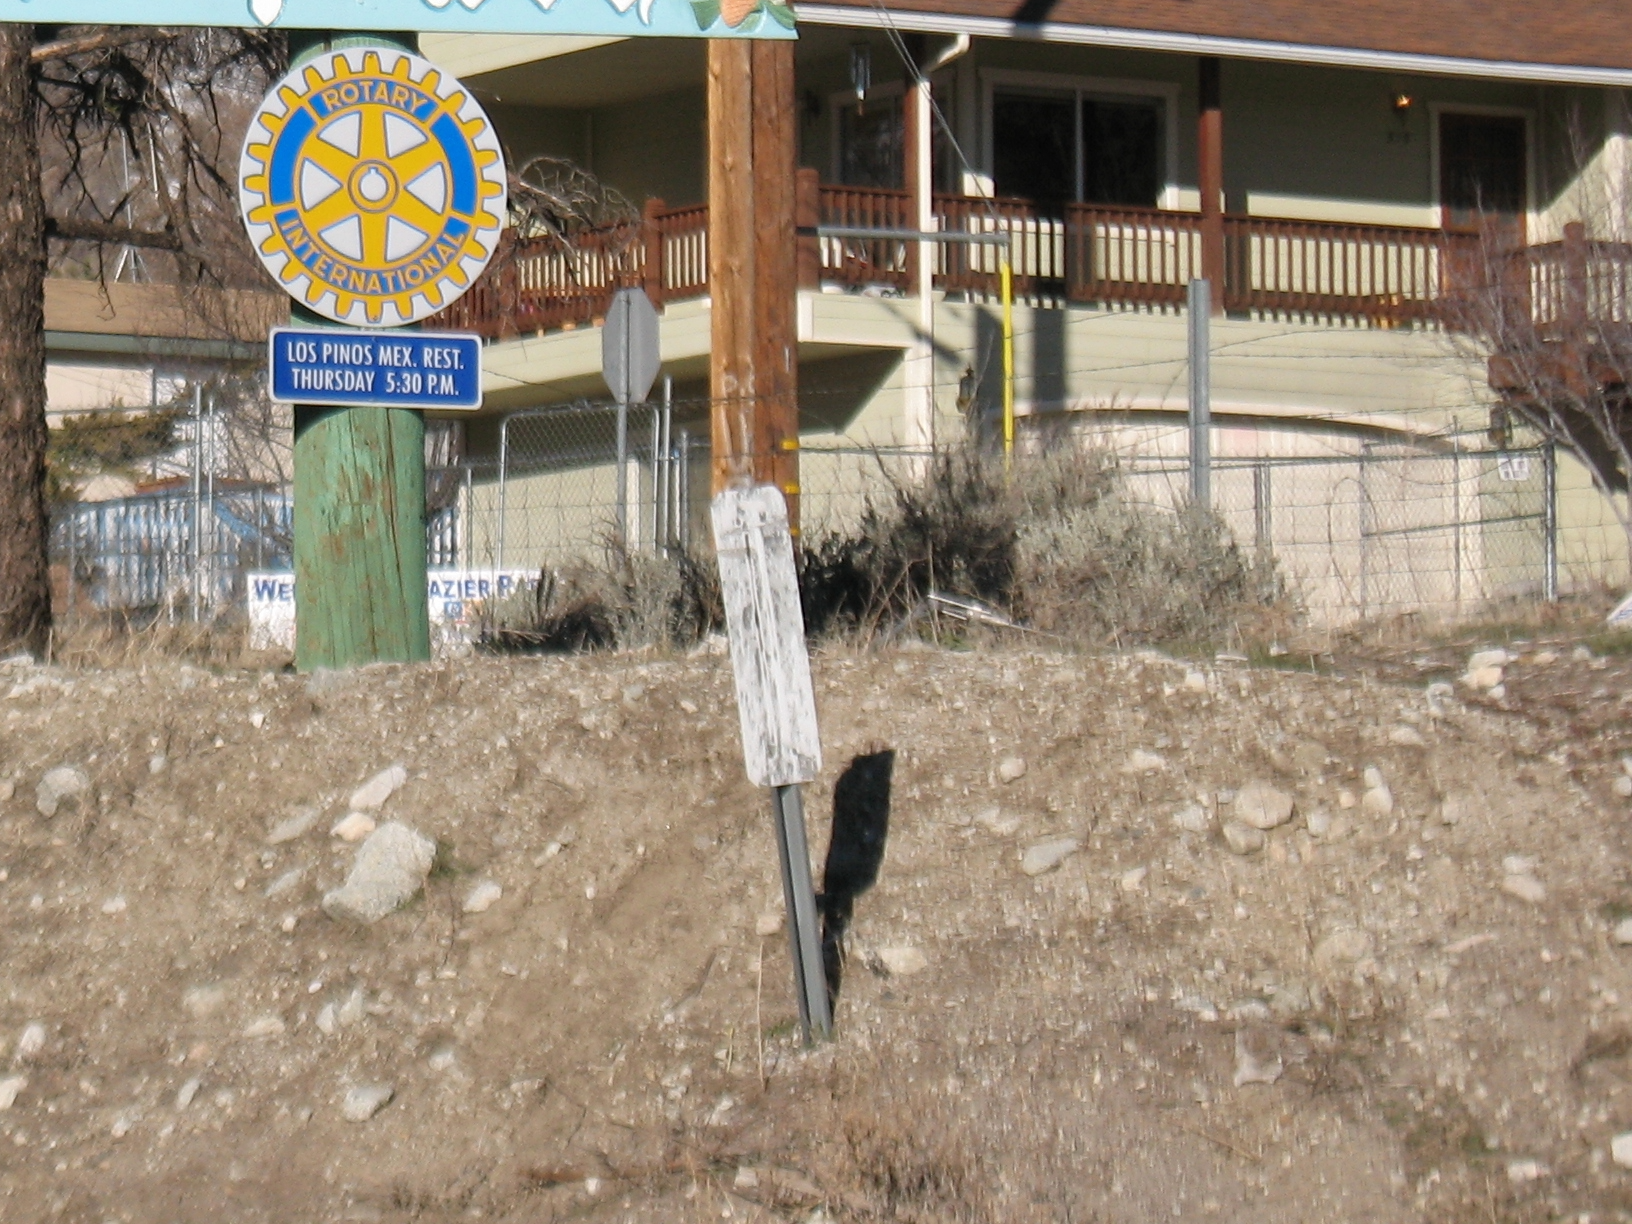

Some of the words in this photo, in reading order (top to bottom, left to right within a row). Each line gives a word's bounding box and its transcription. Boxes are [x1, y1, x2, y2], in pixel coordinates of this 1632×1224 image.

[321, 80, 428, 113] ROTARY
[282, 218, 465, 294] INTERNATIONAL
[287, 341, 317, 364] LOS
[322, 342, 373, 366] PINOS
[378, 345, 418, 368] MEX.
[423, 347, 465, 370] REST.
[291, 367, 376, 392] THURSDAY
[385, 373, 422, 394] 5:30
[428, 374, 460, 396] P.M.
